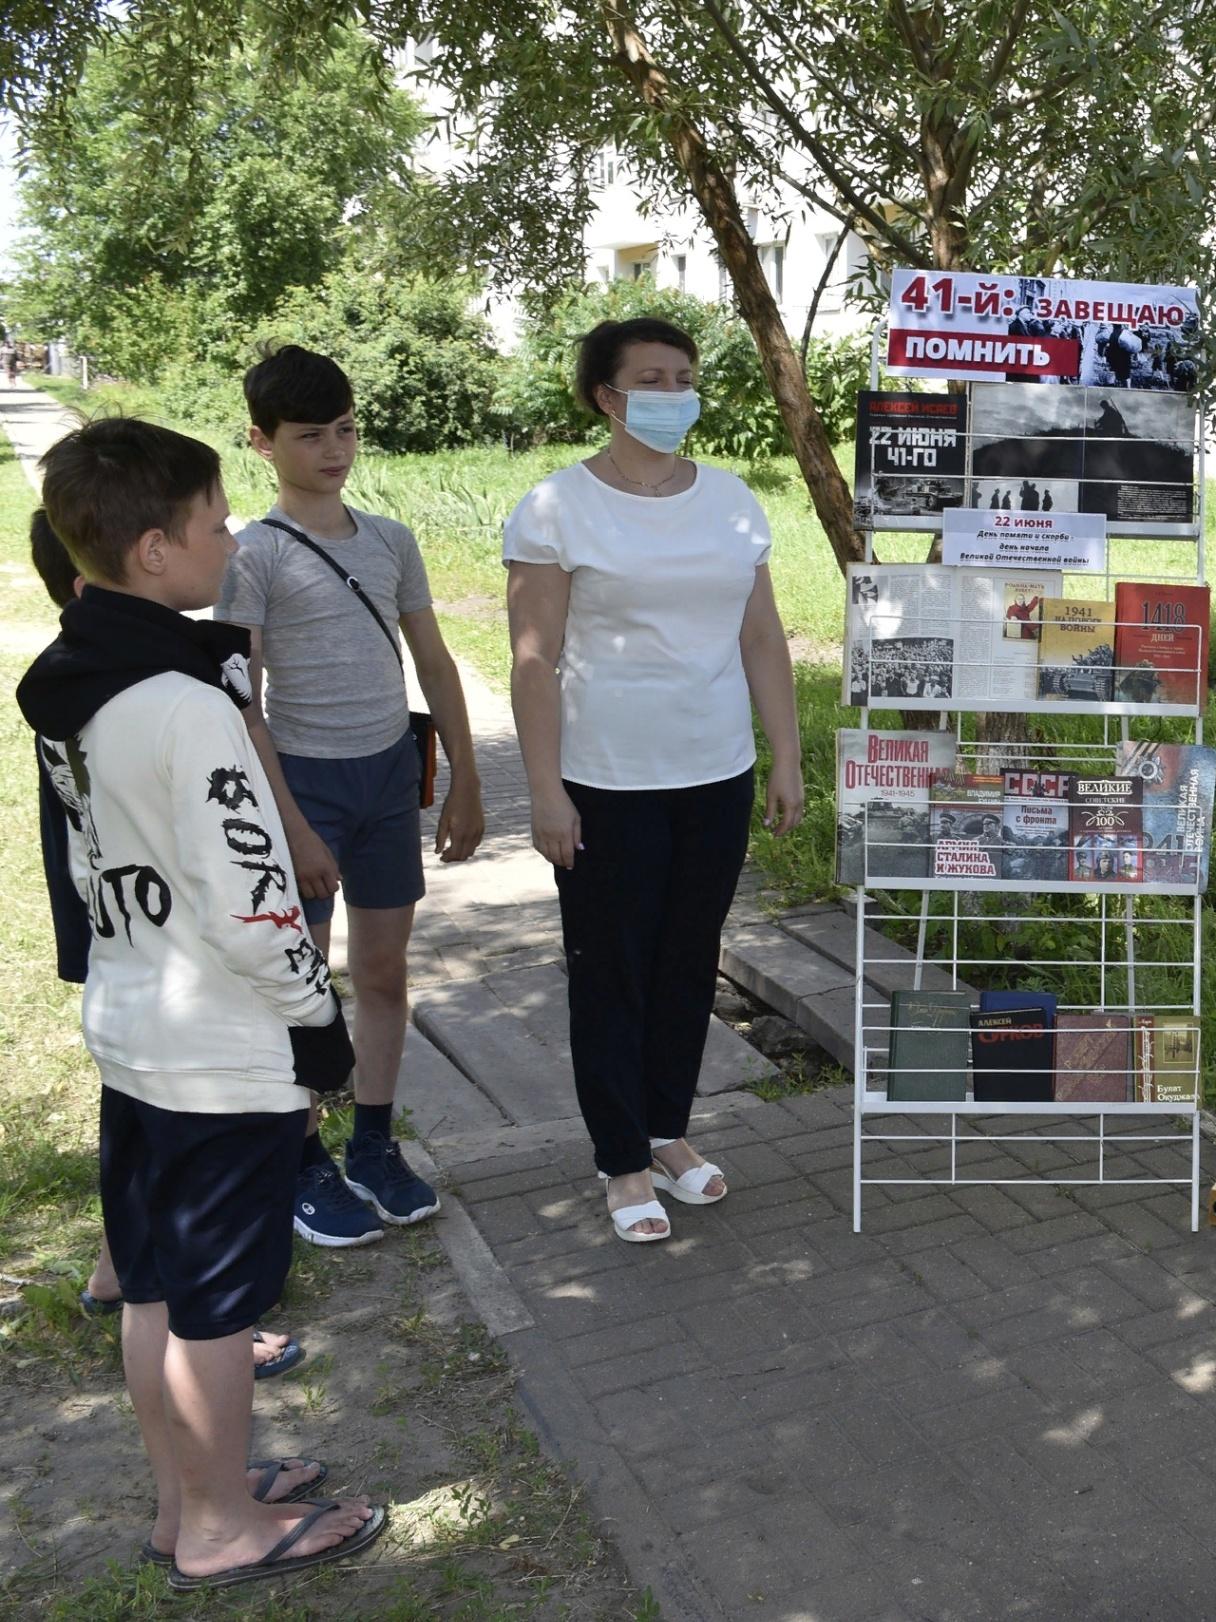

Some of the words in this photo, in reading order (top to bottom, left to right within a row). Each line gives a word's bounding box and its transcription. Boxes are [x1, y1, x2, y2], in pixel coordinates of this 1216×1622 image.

[1036, 298, 1185, 329] ЗАВЕЩАЮ
[905, 336, 1050, 367] ПОМНИТЬ
[869, 426, 892, 445] 22
[898, 427, 957, 447] ИЮНЯ
[887, 447, 937, 467] 41-ГО
[995, 516, 1010, 527] 22
[977, 530, 998, 538] День
[1041, 532, 1070, 541] скорби
[960, 552, 994, 560] Великой
[996, 553, 1062, 563] Отечественной
[1063, 555, 1089, 564] войны
[1065, 606, 1092, 617] 1941
[1142, 601, 1185, 632] 1418
[1078, 783, 1132, 792] ВЕЛИКИЕ
[1021, 804, 1053, 815] Письма
[1177, 785, 1189, 832] ВЕЛИКАЯ
[1023, 815, 1057, 825] фронта
[1096, 816, 1115, 826] 100
[937, 852, 989, 864] СТАЛИНА
[937, 864, 945, 873] И
[947, 864, 995, 874] ЖУКОВА
[1157, 1084, 1182, 1094] Булат
